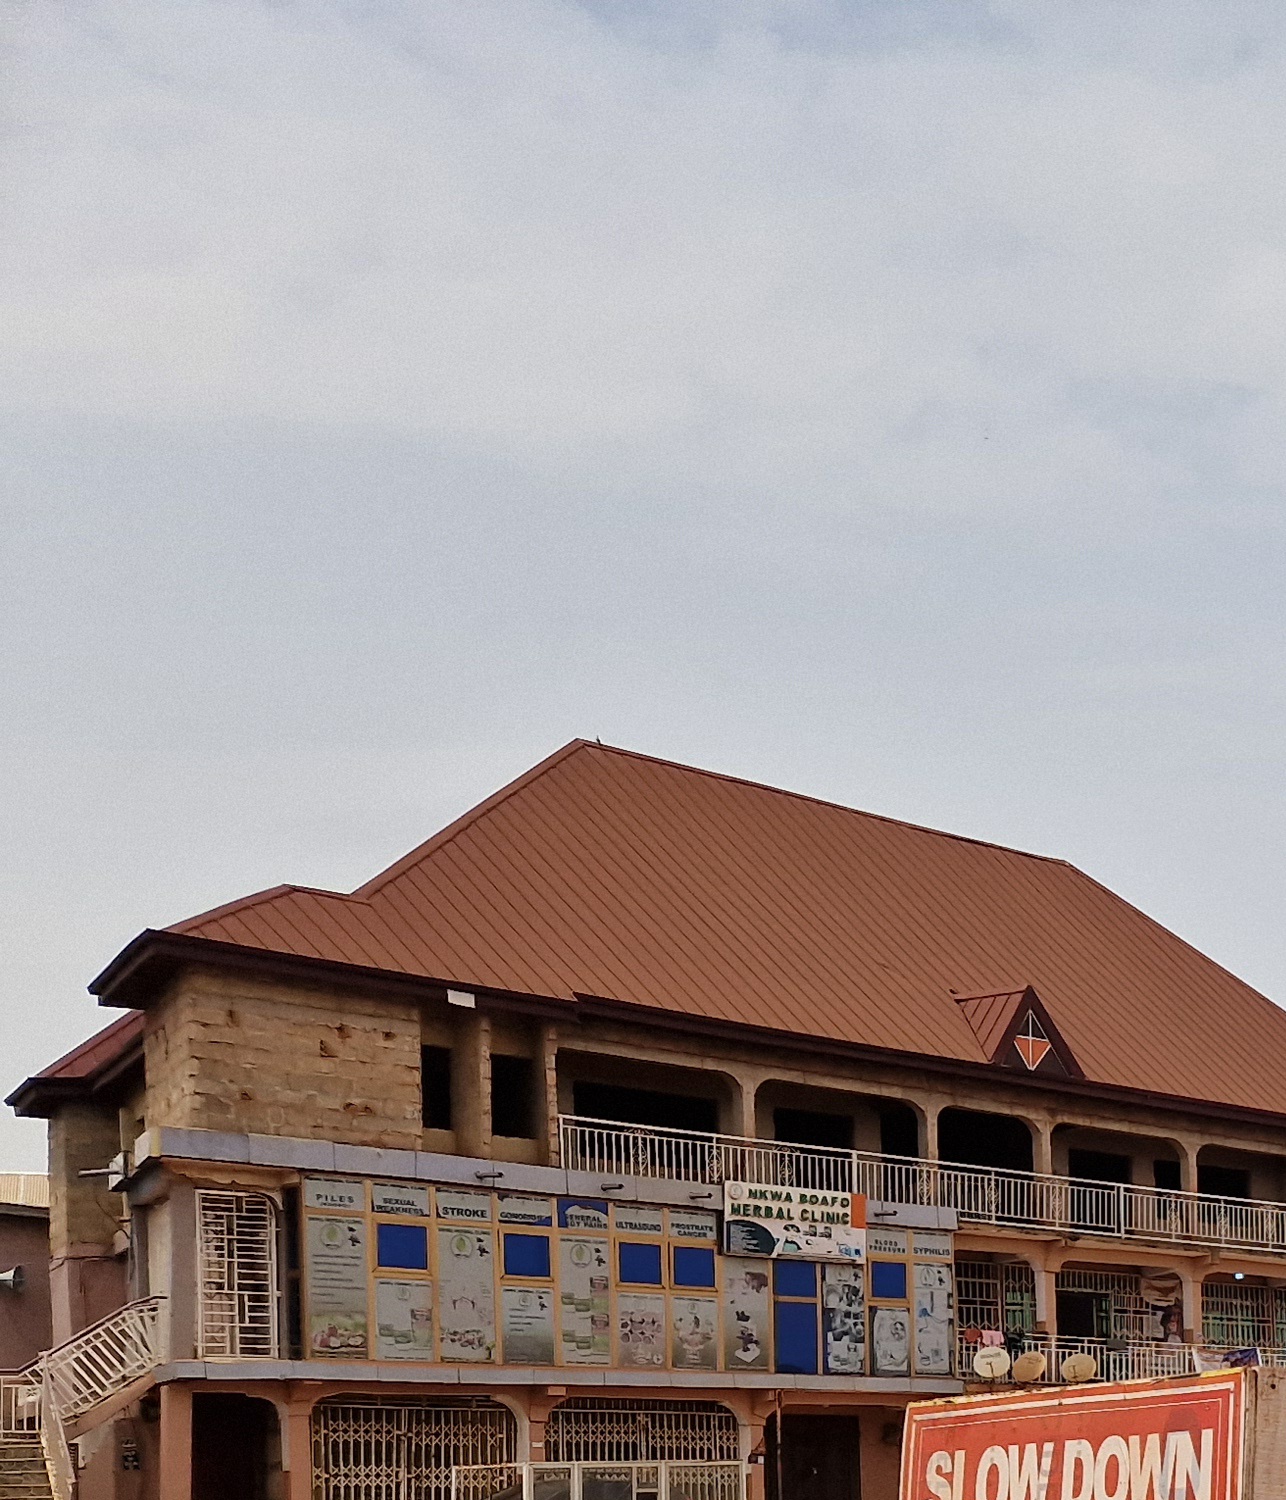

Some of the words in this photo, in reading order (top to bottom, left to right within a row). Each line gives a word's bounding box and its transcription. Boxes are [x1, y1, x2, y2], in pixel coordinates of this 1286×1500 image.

[316, 1194, 354, 1203] PILES
[382, 1198, 417, 1206] SEXUAL
[748, 1188, 793, 1203] NKWA
[798, 1193, 850, 1208] BOAFO
[442, 1206, 487, 1218] STROKE
[730, 1203, 794, 1220] HERBAL
[800, 1208, 850, 1225] CLINIC
[913, 1247, 950, 1256] SYPHILIS
